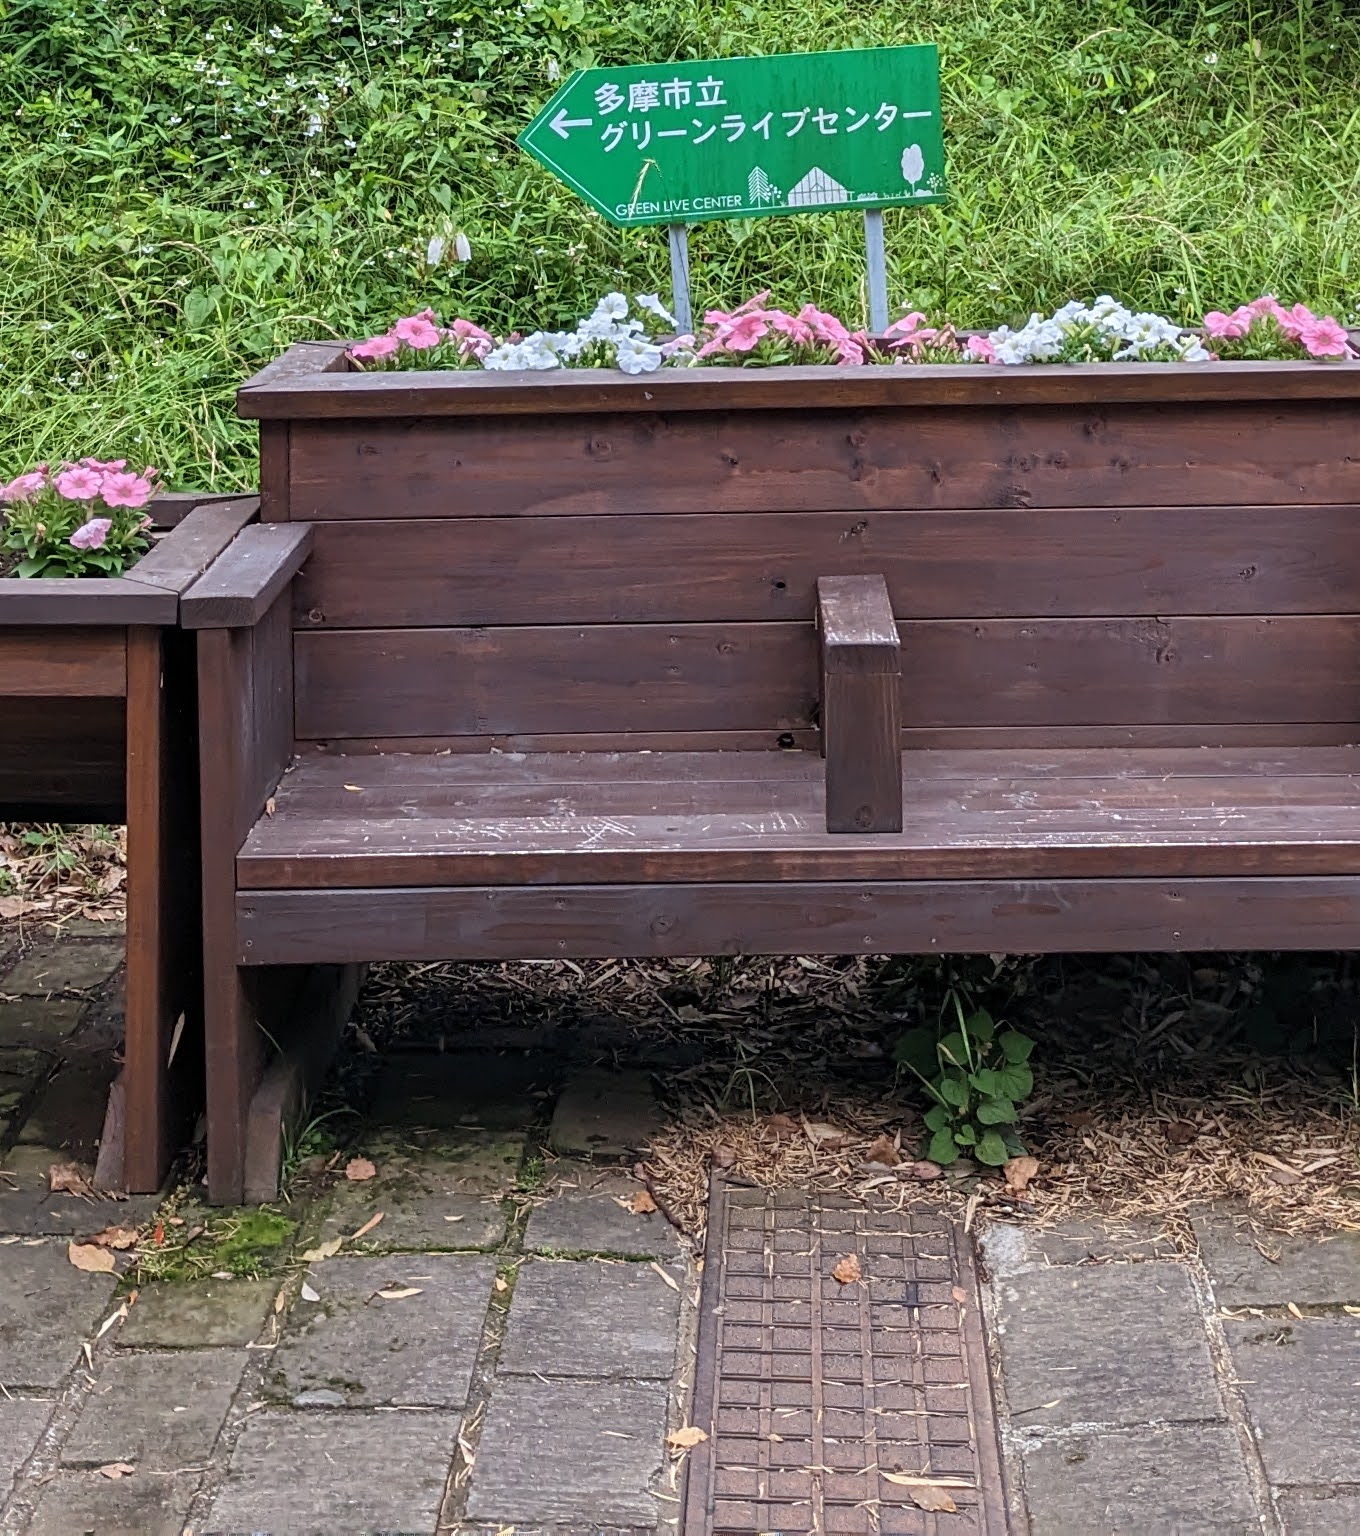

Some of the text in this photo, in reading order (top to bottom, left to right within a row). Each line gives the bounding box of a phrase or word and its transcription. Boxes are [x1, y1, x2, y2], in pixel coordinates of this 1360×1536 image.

[594, 75, 728, 116] 多摩市立
[600, 102, 932, 152] グリーンライブセンター
[615, 195, 742, 216] GREEN LIVE CENTER
